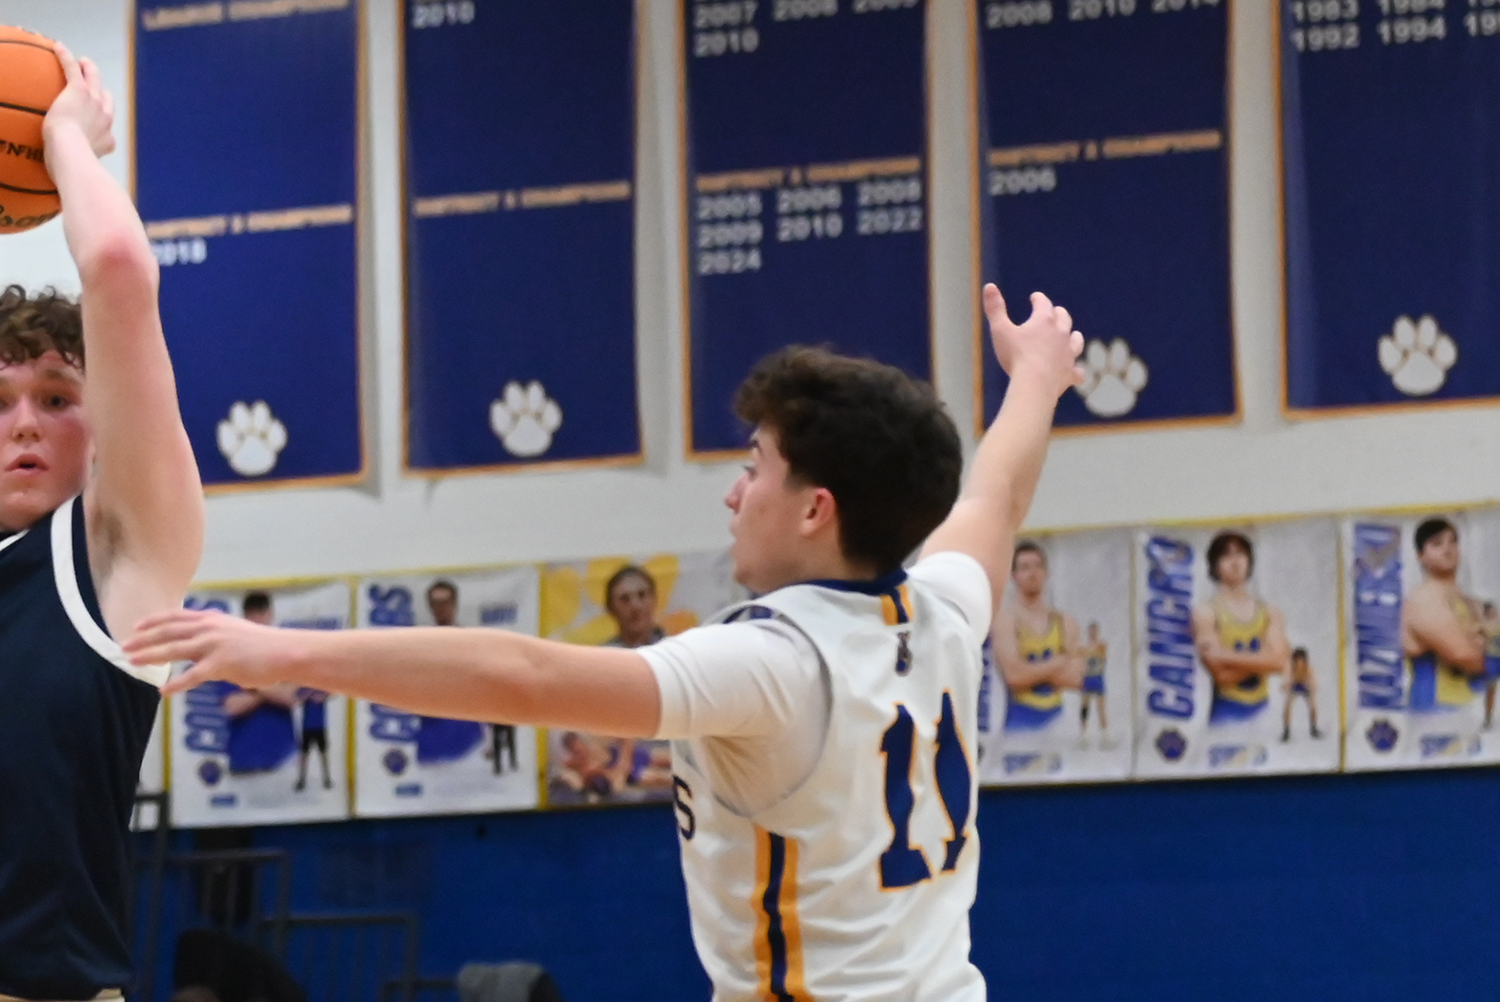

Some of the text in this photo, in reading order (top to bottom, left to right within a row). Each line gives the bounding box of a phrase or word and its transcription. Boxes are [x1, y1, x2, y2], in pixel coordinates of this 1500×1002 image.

[695, 27, 758, 57] 2010
[1291, 24, 1359, 51] 1992
[1376, 16, 1446, 44] 1994
[777, 212, 843, 242] 2010
[699, 248, 762, 275] 2024
